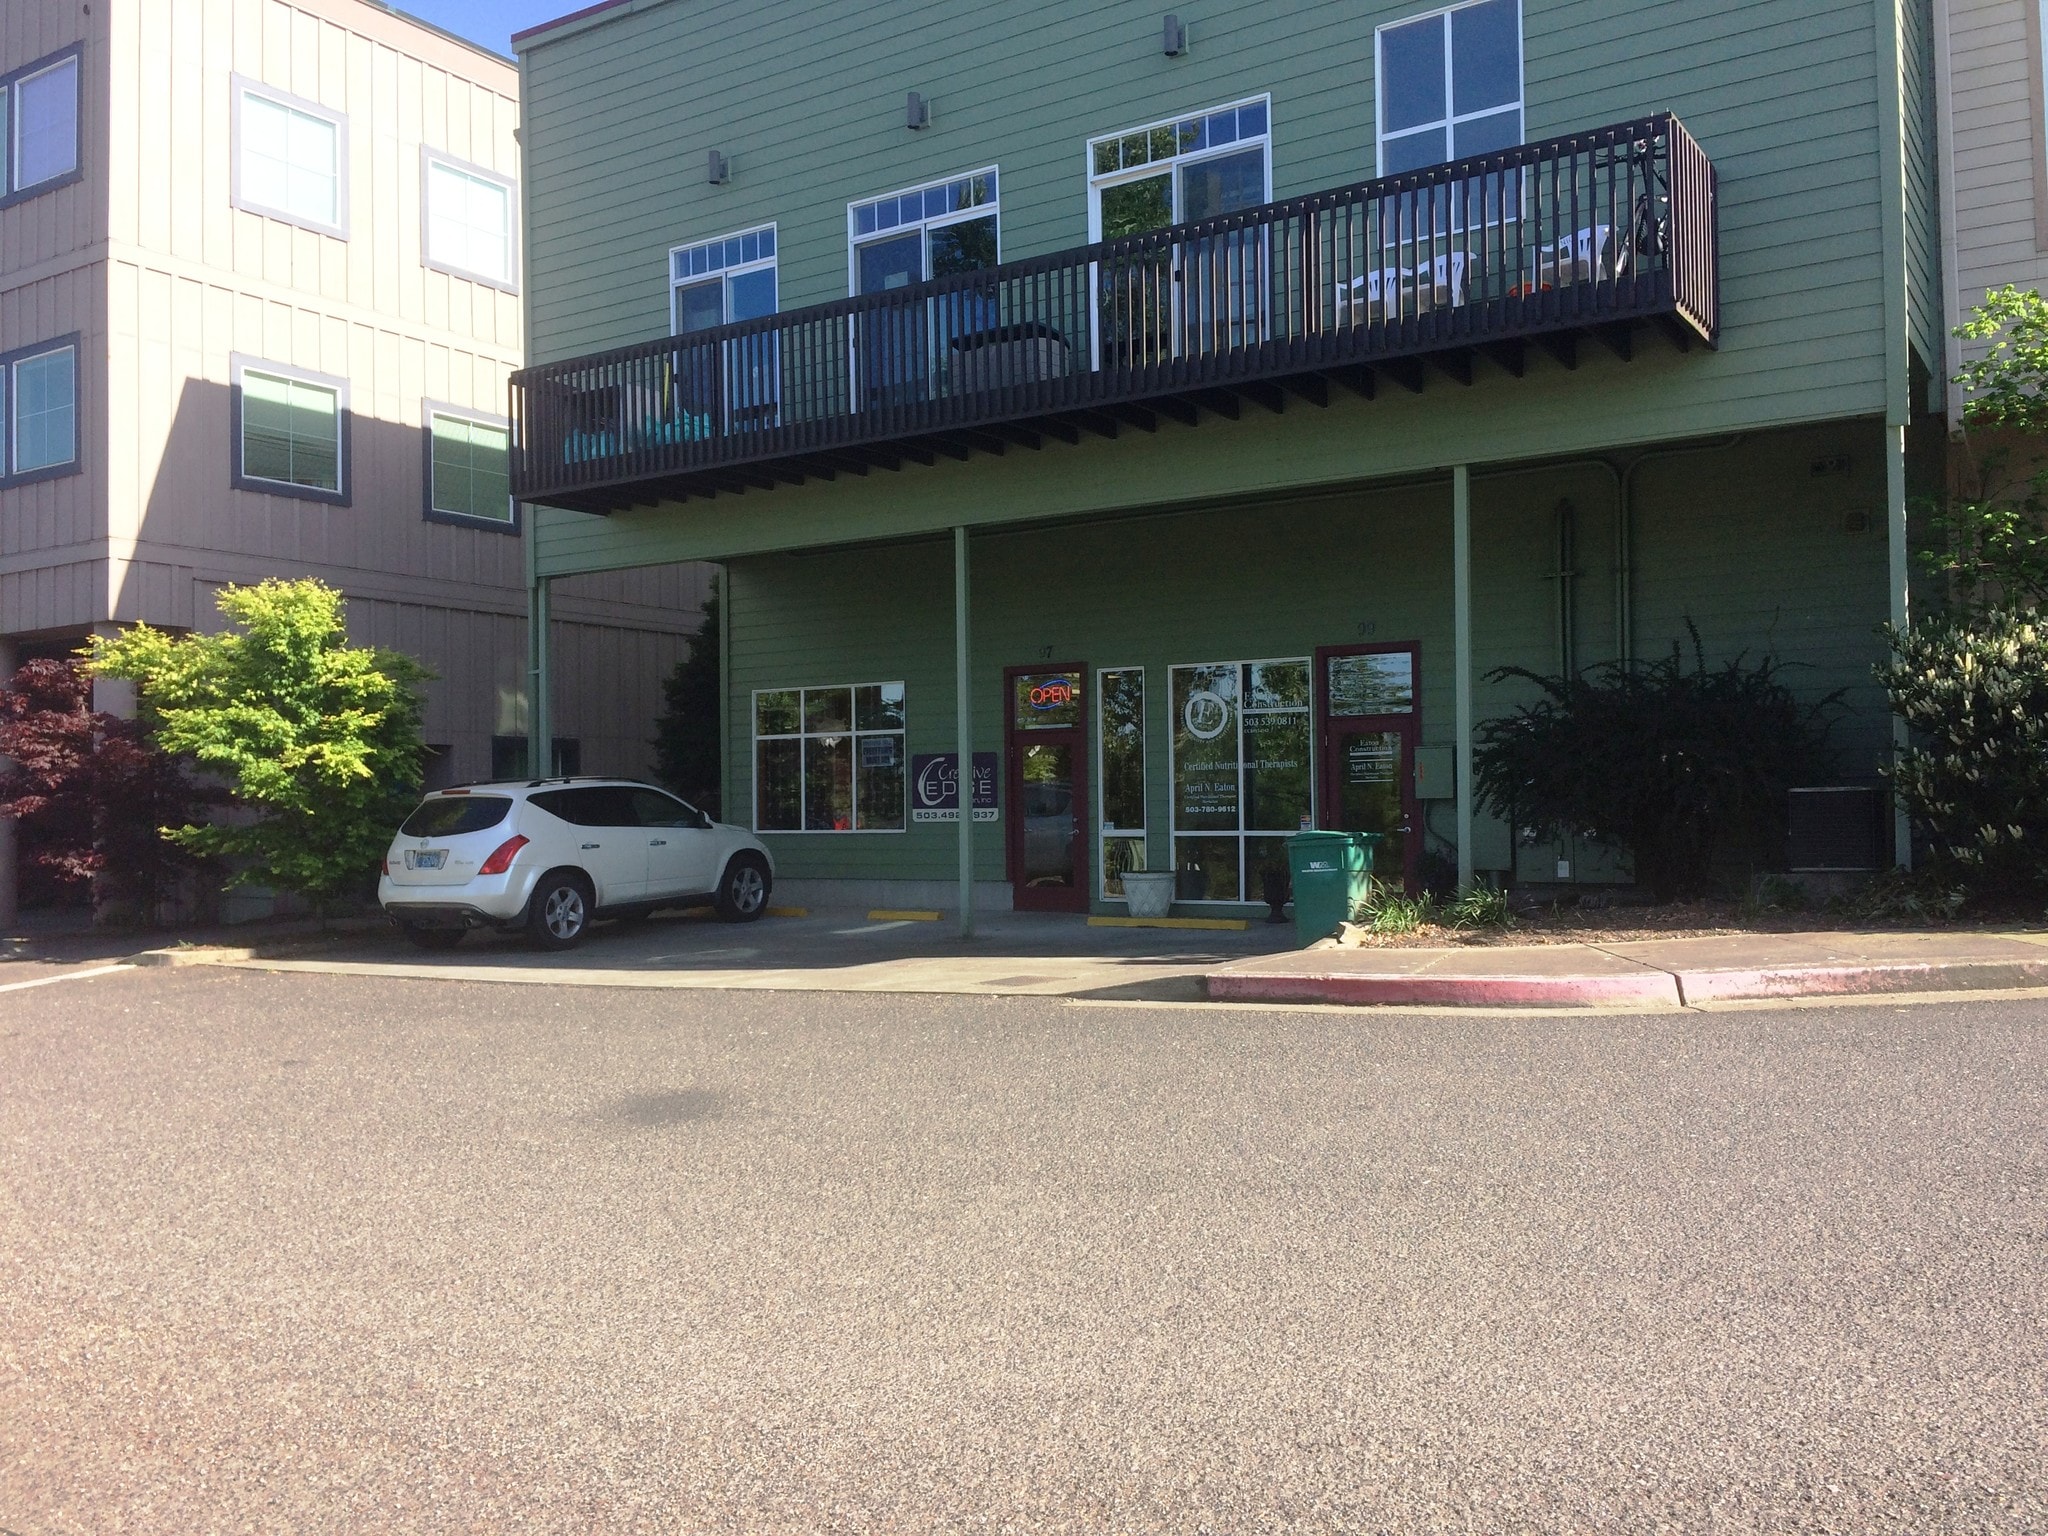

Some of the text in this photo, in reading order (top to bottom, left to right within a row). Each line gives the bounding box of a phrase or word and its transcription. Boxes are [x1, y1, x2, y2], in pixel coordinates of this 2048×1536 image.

[1030, 685, 1071, 704] OPEN
[1243, 700, 1303, 708] Construction
[1244, 717, 1260, 727] 503
[1277, 716, 1297, 726] 0811
[1184, 762, 1214, 771] Certified
[1261, 760, 1298, 769] Therapists
[938, 763, 992, 781] Creive
[926, 780, 992, 796] EDE
[1184, 784, 1203, 795] April
[1214, 783, 1236, 792] Eaton
